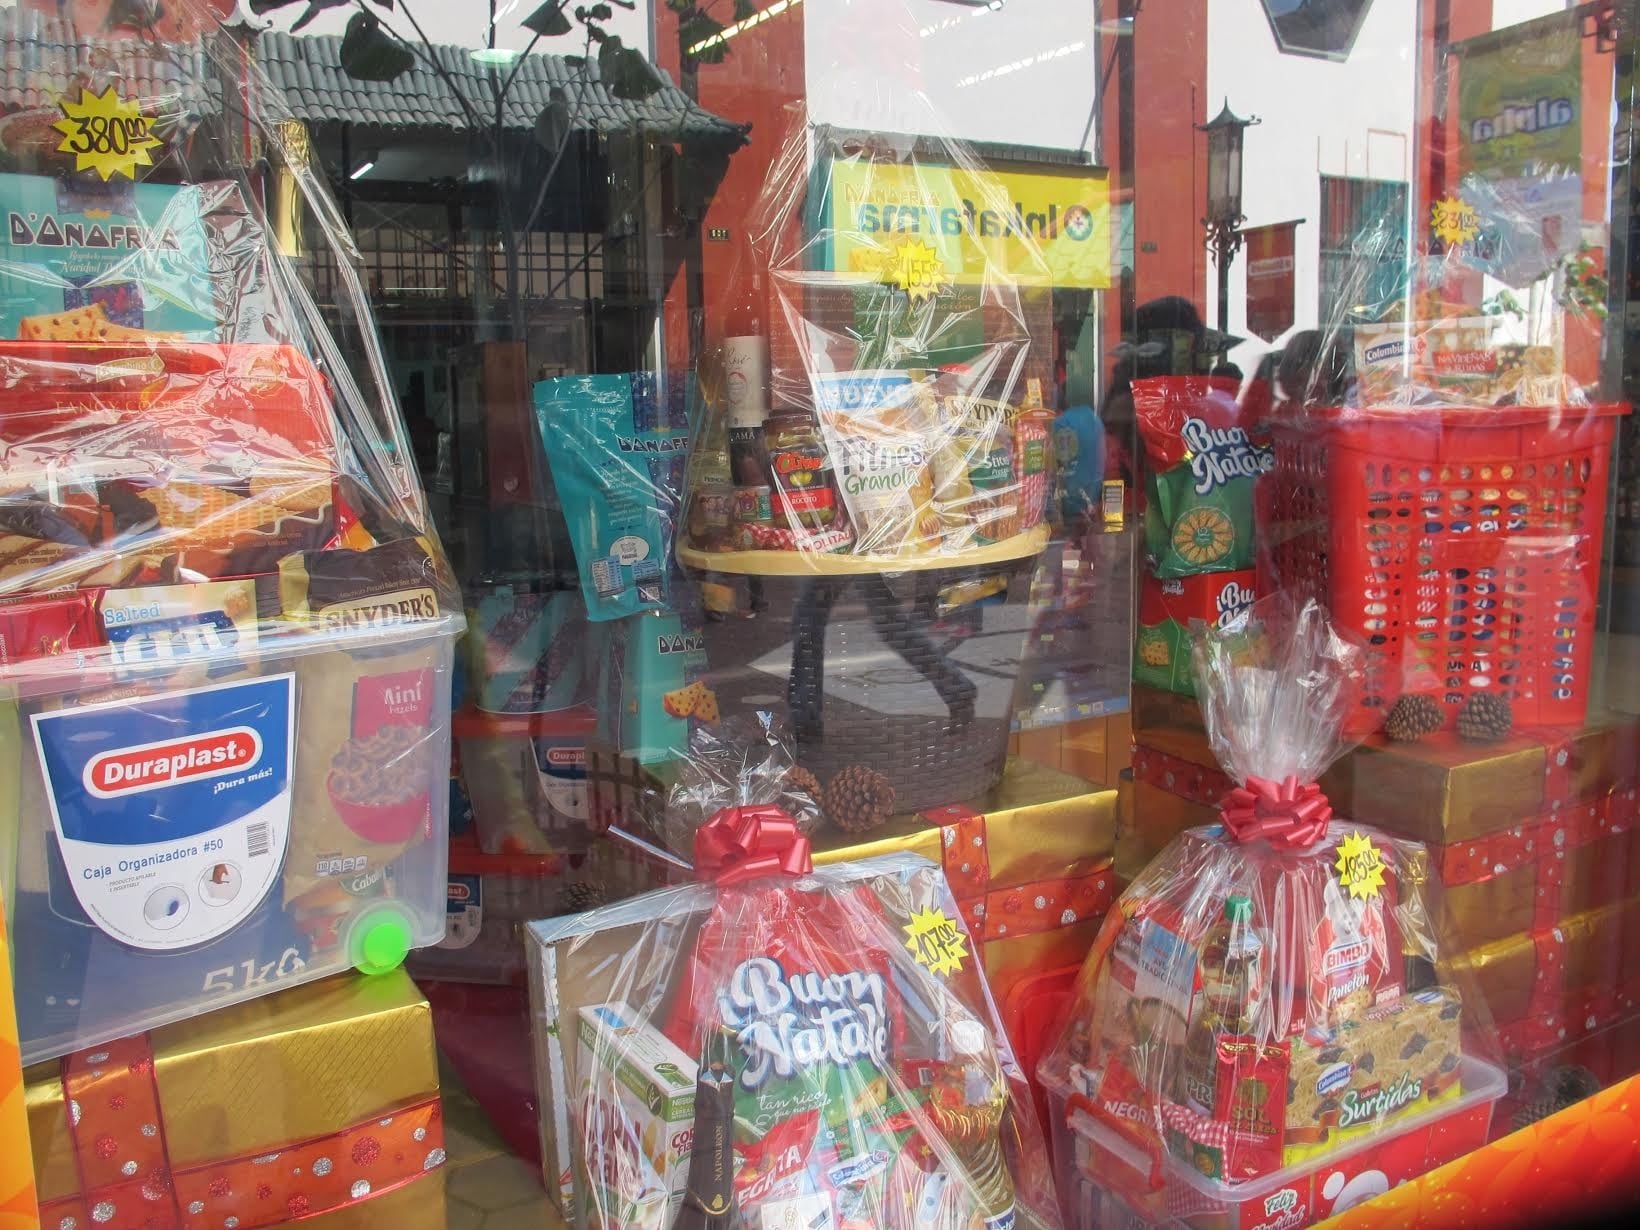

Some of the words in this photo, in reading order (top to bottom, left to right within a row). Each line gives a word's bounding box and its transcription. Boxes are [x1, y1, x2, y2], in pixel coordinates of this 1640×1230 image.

[1366, 340, 1416, 361] Colombi
[845, 467, 923, 495] Granola
[104, 603, 160, 624] Salted
[327, 594, 435, 628] SNYDER'S
[104, 740, 237, 784] Duraplast
[213, 778, 245, 794] ¡Dura
[248, 767, 273, 783] más!
[83, 866, 112, 880] Caja
[118, 845, 198, 872] Organizadora
[203, 838, 224, 851] #50
[1327, 941, 1370, 968] BIMBO
[1327, 973, 1370, 1008] Panetón
[1338, 1071, 1422, 1127] Surtidas
[714, 1126, 723, 1182] NAPOLEON
